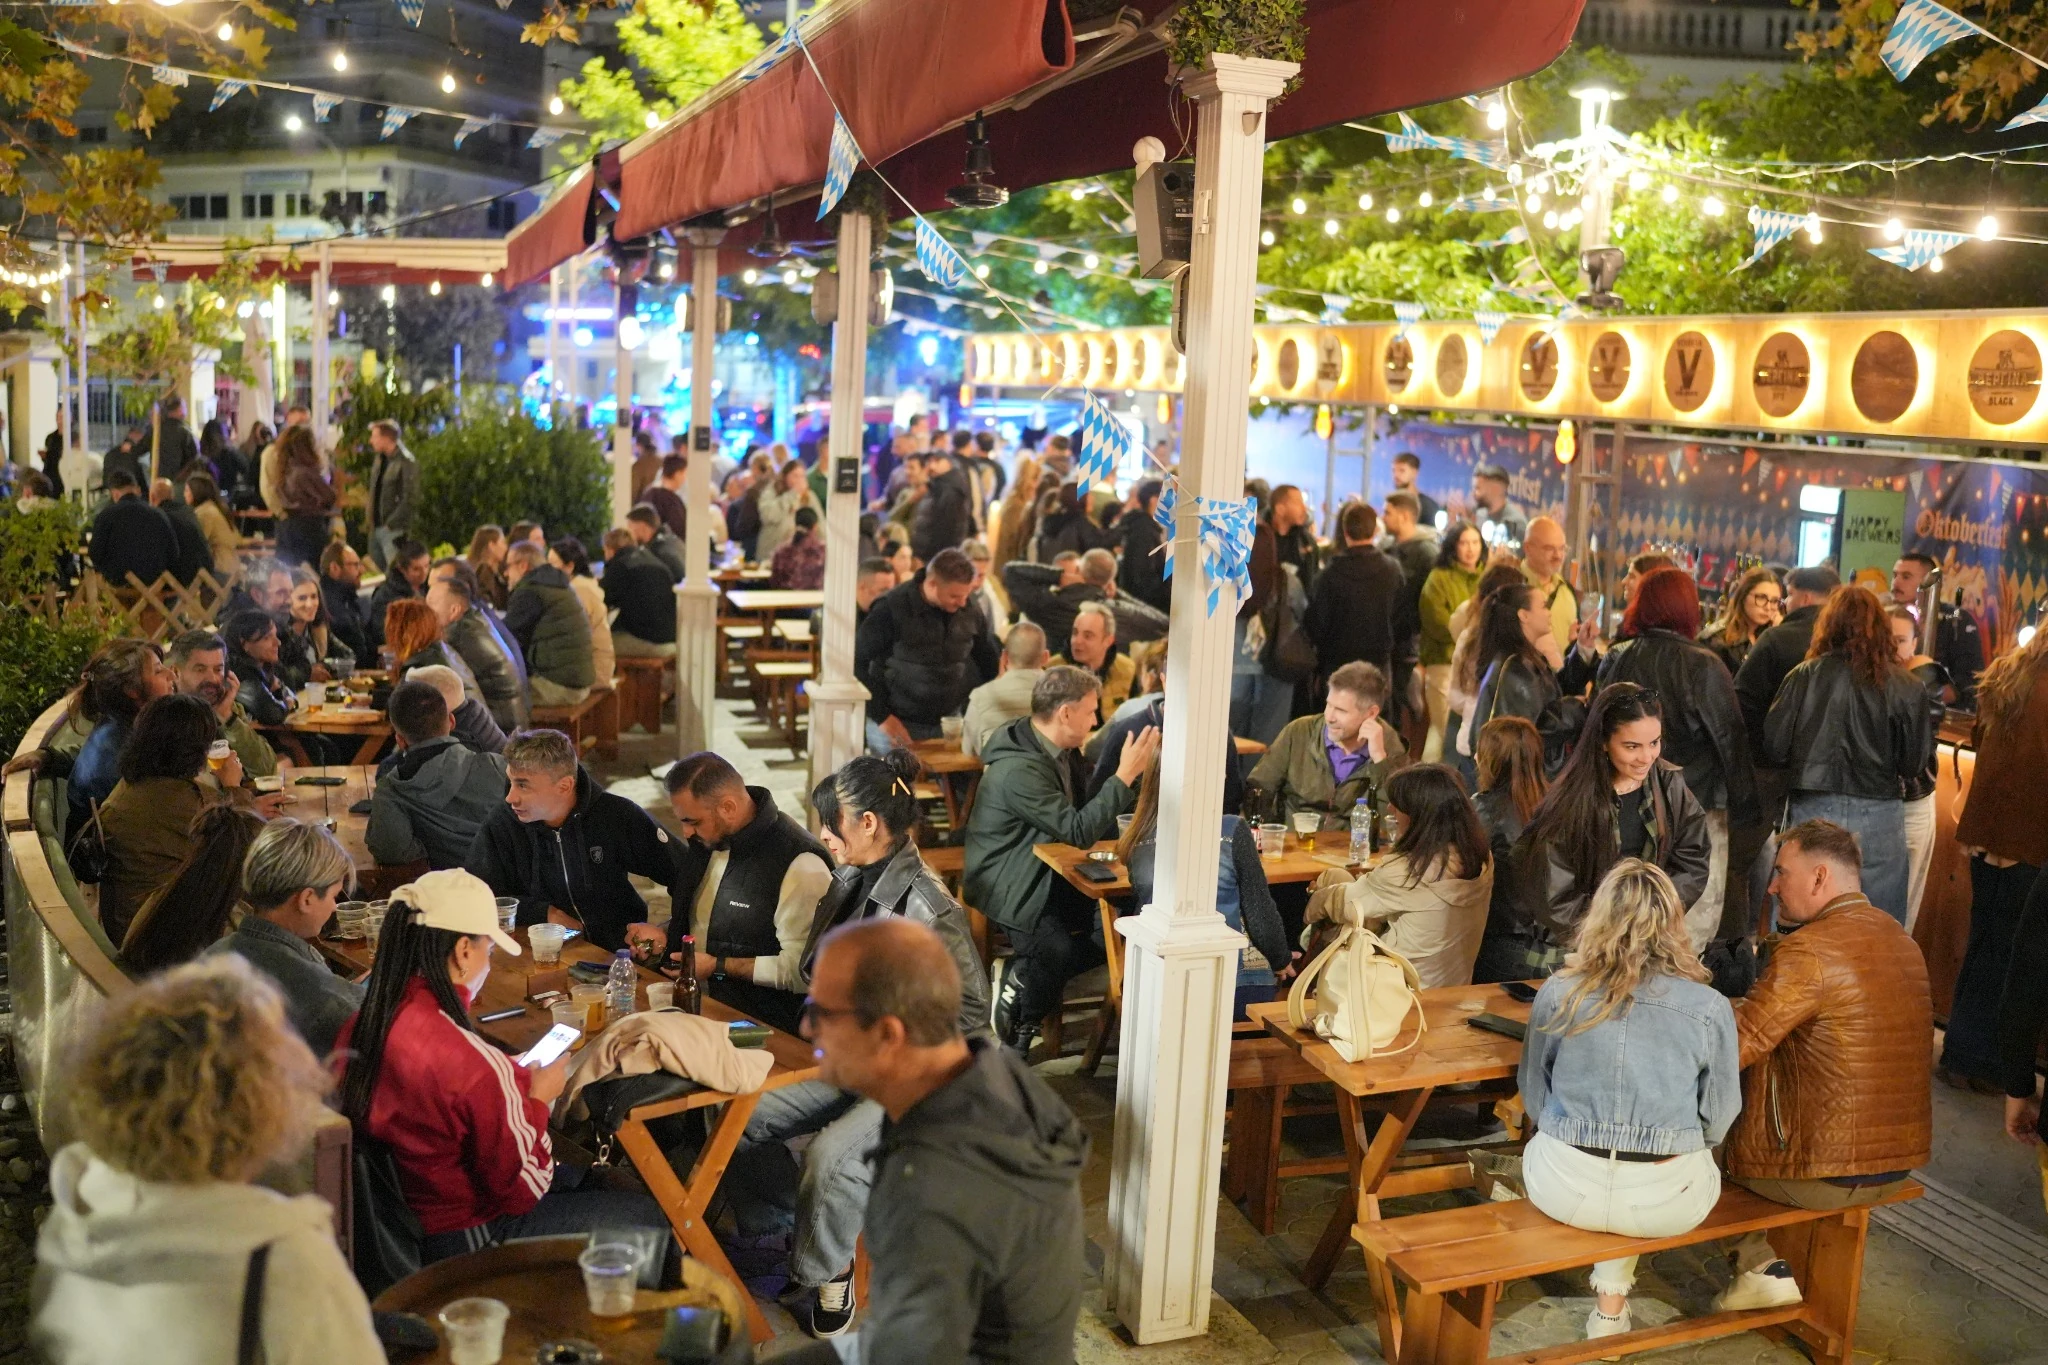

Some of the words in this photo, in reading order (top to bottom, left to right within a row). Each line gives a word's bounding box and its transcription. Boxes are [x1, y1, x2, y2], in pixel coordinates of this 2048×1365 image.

[1677, 350, 1702, 389] V
[1988, 397, 2013, 406] BLACK
[1851, 516, 1889, 528] HAPPY
[1915, 509, 2010, 550] Oktoberfest
[1845, 529, 1901, 545] BREWERS
